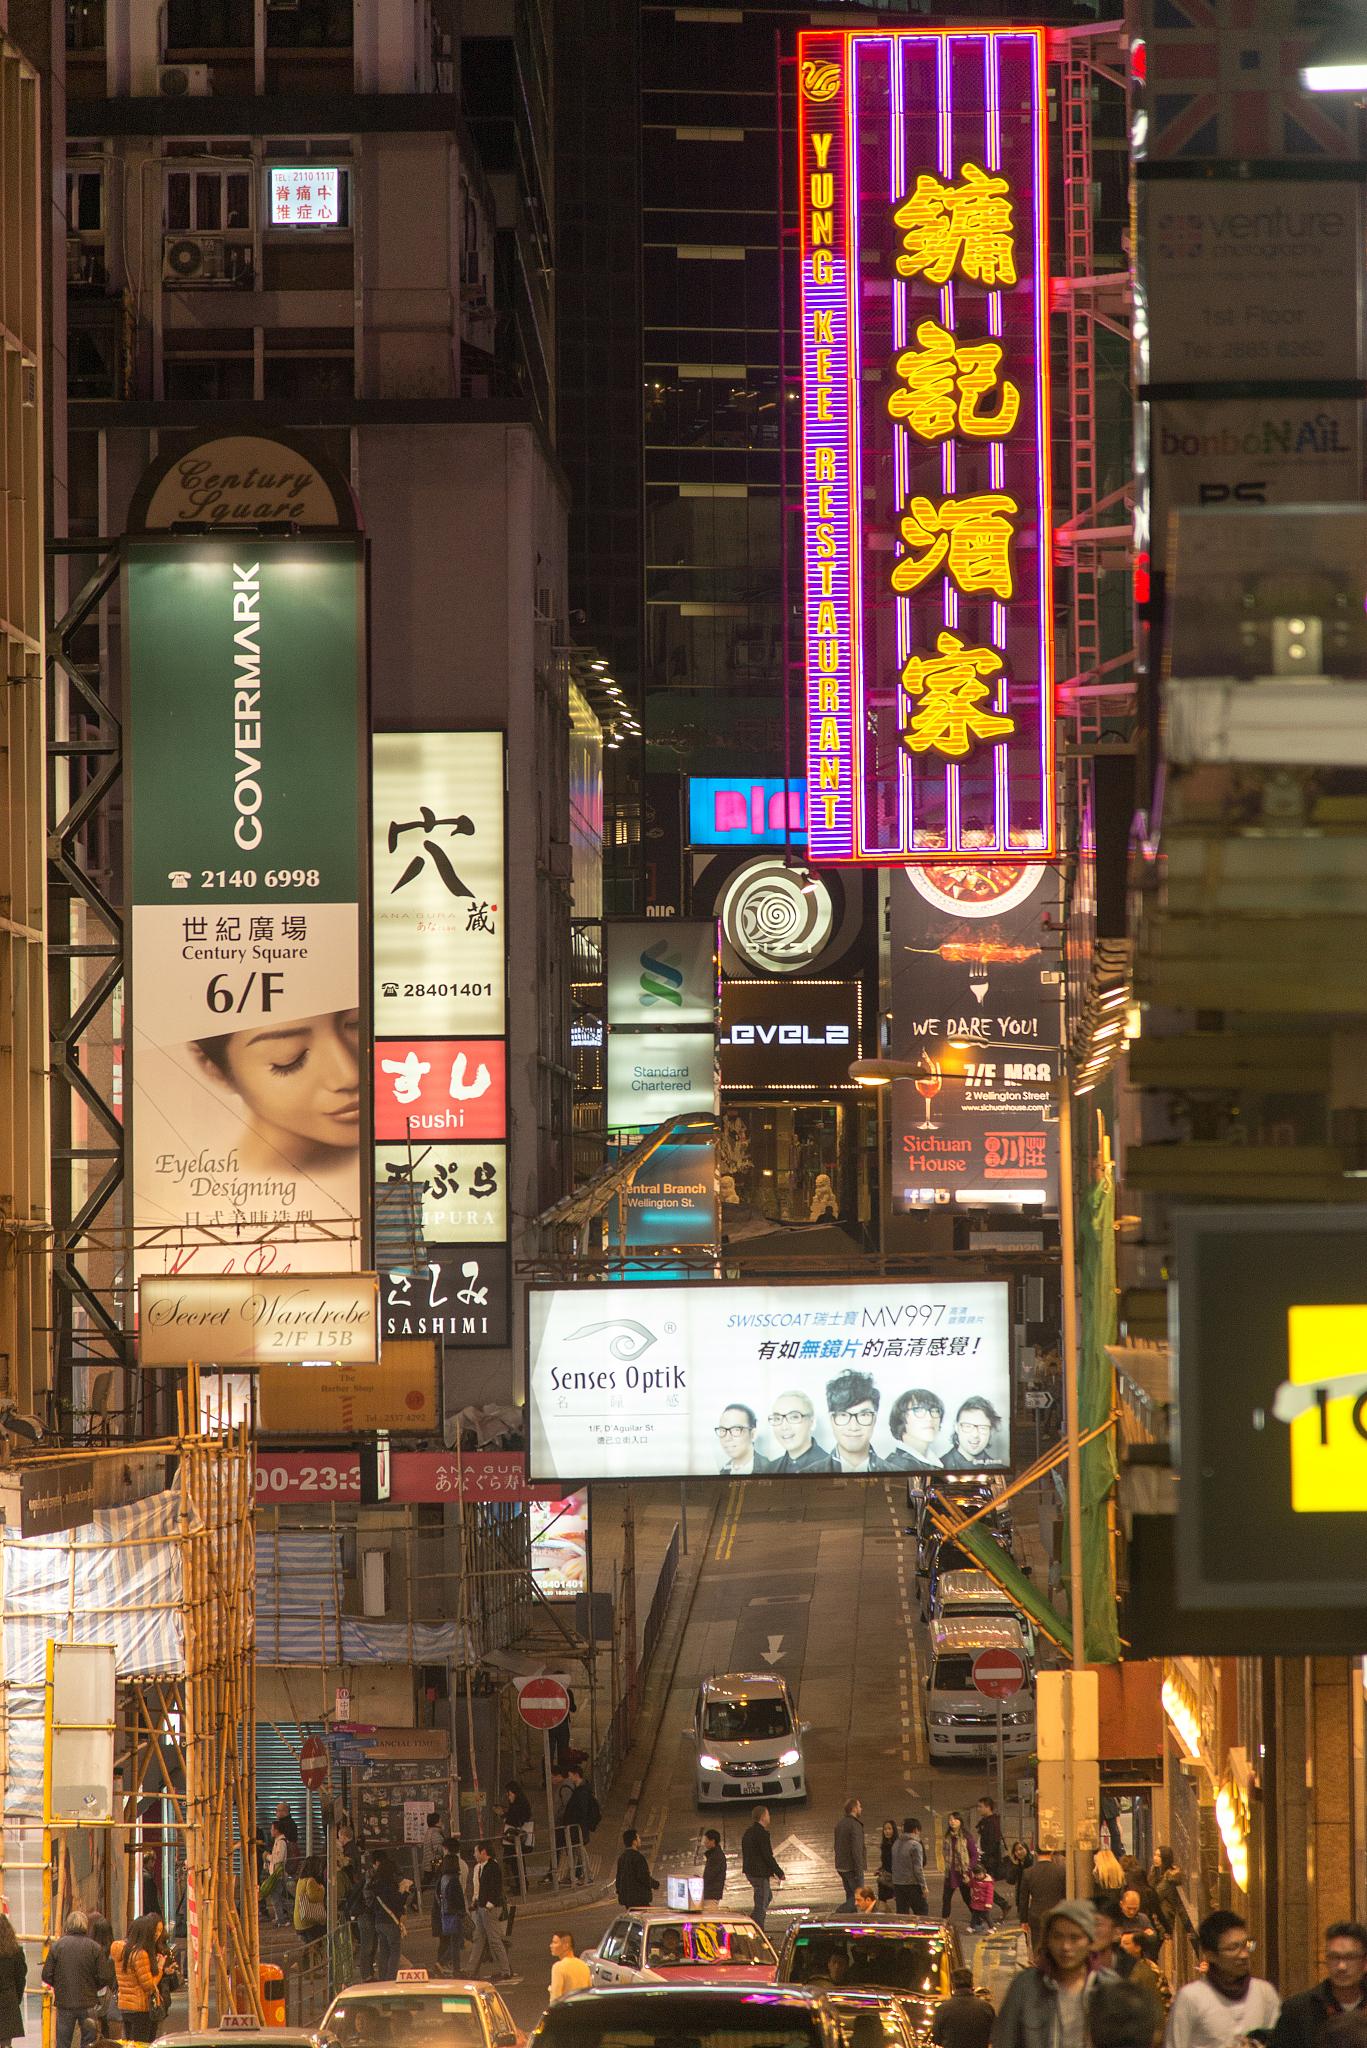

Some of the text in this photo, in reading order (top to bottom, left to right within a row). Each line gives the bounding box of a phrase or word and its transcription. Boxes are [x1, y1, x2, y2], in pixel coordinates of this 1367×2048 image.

[293, 172, 313, 181] 2110
[316, 172, 335, 181] 1117
[810, 133, 841, 830] YUNG KEE RESTAURANT
[178, 459, 313, 525] Century Square
[232, 562, 264, 851] COVERMARK
[201, 869, 320, 888] 2140 6998
[182, 915, 307, 942] 世紀廣場
[181, 944, 309, 964] Century Square
[206, 972, 285, 1014] 6/F
[403, 983, 493, 997] 28401401
[912, 1016, 1038, 1037] WE DARE YOU!
[381, 1051, 492, 1104] すし
[633, 1066, 690, 1078] Standard
[963, 1063, 997, 1087] 7/F
[631, 1080, 692, 1091] Chartered
[965, 1091, 1050, 1102] 2 Wellington Street
[960, 1103, 1052, 1111] www.sichuanhouse.com.h
[409, 1109, 465, 1129] sushi
[903, 1134, 973, 1152] Sichuan
[155, 1148, 240, 1184] Eyelash
[908, 1154, 967, 1172] House
[189, 1176, 297, 1206] Designing
[663, 1183, 707, 1194] Branch
[627, 1198, 695, 1209] Wellington St.
[147, 1289, 371, 1333] Secret Wardrobe
[727, 1313, 811, 1328] SWISSCOAT
[861, 1304, 947, 1328] MV997
[387, 1317, 488, 1334] SASHIMI
[272, 1330, 354, 1347] 2/F 15B
[340, 1374, 355, 1382] The
[551, 1365, 687, 1393] Senses Optik
[321, 1384, 374, 1394] Barber Shop
[645, 1424, 657, 1432] St.
[435, 1465, 523, 1474] ANA GUR
[255, 1466, 361, 1492] 00-23:3
[399, 1971, 427, 1981] TAXI
[223, 2017, 255, 2027] TAXI
